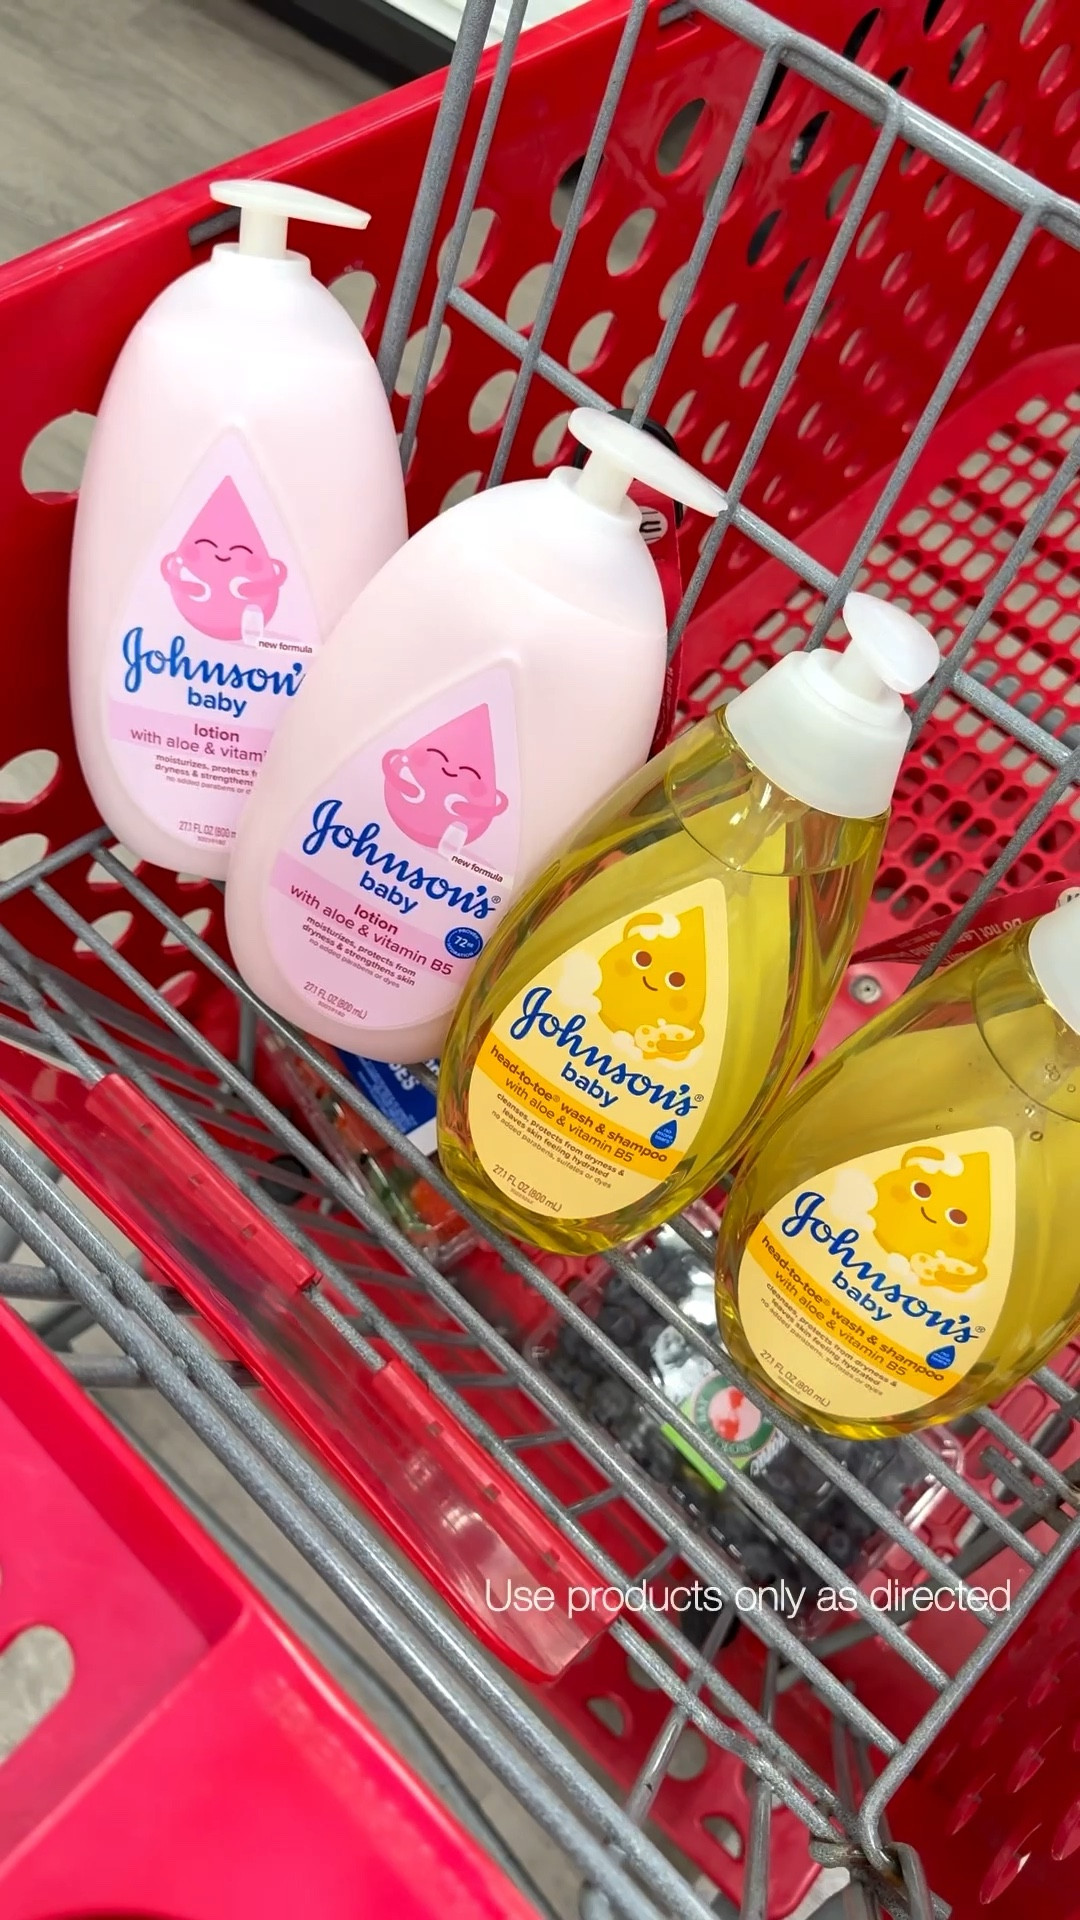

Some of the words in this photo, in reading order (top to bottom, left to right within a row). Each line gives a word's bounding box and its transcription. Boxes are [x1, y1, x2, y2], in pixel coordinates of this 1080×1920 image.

[123, 627, 306, 697] Johnson'
[258, 640, 277, 648] new
[279, 642, 312, 653] formula
[187, 686, 247, 718] baby
[130, 729, 161, 744] with
[166, 736, 199, 752] aloe
[204, 742, 215, 755] &
[220, 746, 267, 762] vitam
[194, 724, 239, 742] lotion
[155, 763, 189, 776] dryness
[156, 754, 209, 770] moisturizes,
[212, 765, 249, 776] protects
[177, 777, 199, 786] added
[201, 782, 235, 793] parabens
[194, 822, 202, 833] FL
[204, 825, 214, 835] OZ
[360, 871, 418, 914] baby
[451, 855, 471, 868] new
[471, 864, 503, 882] formula
[290, 885, 320, 909] with
[322, 906, 355, 929] aloe
[358, 925, 369, 937] &
[374, 933, 427, 965] vitamin
[430, 959, 453, 975] B5
[354, 904, 398, 935] lotion
[981, 925, 1002, 938] not
[302, 924, 335, 947] dryness
[344, 947, 395, 978] strengthens
[397, 973, 415, 986] skin
[307, 916, 357, 948] moisturizes,
[358, 945, 393, 967] protects
[395, 963, 416, 977] from
[309, 938, 318, 947] no
[319, 943, 341, 959] added
[342, 955, 374, 976] parabens
[383, 974, 400, 988] dyes
[304, 981, 317, 993] 27.1
[318, 988, 327, 999] FL
[327, 993, 338, 1005] OZ
[337, 997, 353, 1013] (800
[352, 1008, 367, 1019] mL)
[561, 1061, 618, 1107] baby
[497, 1093, 529, 1121] cleanses,
[531, 1120, 563, 1144] protects
[564, 1140, 583, 1156] from
[585, 1152, 617, 1174] dryness
[503, 1108, 526, 1128] leaves
[527, 1127, 542, 1142] skin
[544, 1137, 571, 1160] feeling
[572, 1156, 609, 1178] hydrated
[505, 1078, 528, 1100] with
[530, 1098, 555, 1119] aloe
[556, 1116, 566, 1128] &
[569, 1124, 612, 1156] vitamin
[614, 1150, 633, 1163] B5
[561, 1102, 594, 1128] wash
[595, 1124, 605, 1135] &
[609, 1130, 667, 1162] shampoo
[491, 1111, 500, 1119] no
[501, 1119, 521, 1137] added
[521, 1134, 556, 1160] parabens,
[556, 1156, 584, 1175] sulfates
[594, 1176, 611, 1189] dyes
[493, 1164, 507, 1179] 27.1
[507, 1174, 517, 1186] FL
[517, 1181, 530, 1194] OZ
[529, 1186, 547, 1204] (800
[546, 1198, 563, 1213] mL)
[832, 1271, 892, 1321] baby
[761, 1298, 769, 1307] no
[769, 1307, 790, 1329] added
[825, 1354, 853, 1378] sulfates
[855, 1376, 863, 1384] or
[864, 1382, 884, 1396] dyes
[767, 1283, 798, 1317] cleanses,
[800, 1316, 832, 1346] protects
[833, 1343, 853, 1360] from
[854, 1358, 888, 1382] dryness
[772, 1298, 795, 1324] leaves
[795, 1321, 812, 1338] skin
[812, 1336, 840, 1361] feeling
[841, 1356, 880, 1386] hydrated
[775, 1270, 798, 1296] with
[799, 1297, 825, 1321] aloe
[826, 1319, 836, 1331] &
[839, 1329, 884, 1364] vitamin
[886, 1361, 907, 1376] B5
[832, 1307, 865, 1337] wash
[867, 1334, 878, 1345] &
[879, 1343, 945, 1382] shampoo
[760, 1350, 774, 1365] 27.1
[774, 1362, 785, 1375] FL
[785, 1372, 797, 1384] OZ
[795, 1379, 814, 1397] (800
[813, 1393, 831, 1407] mL)
